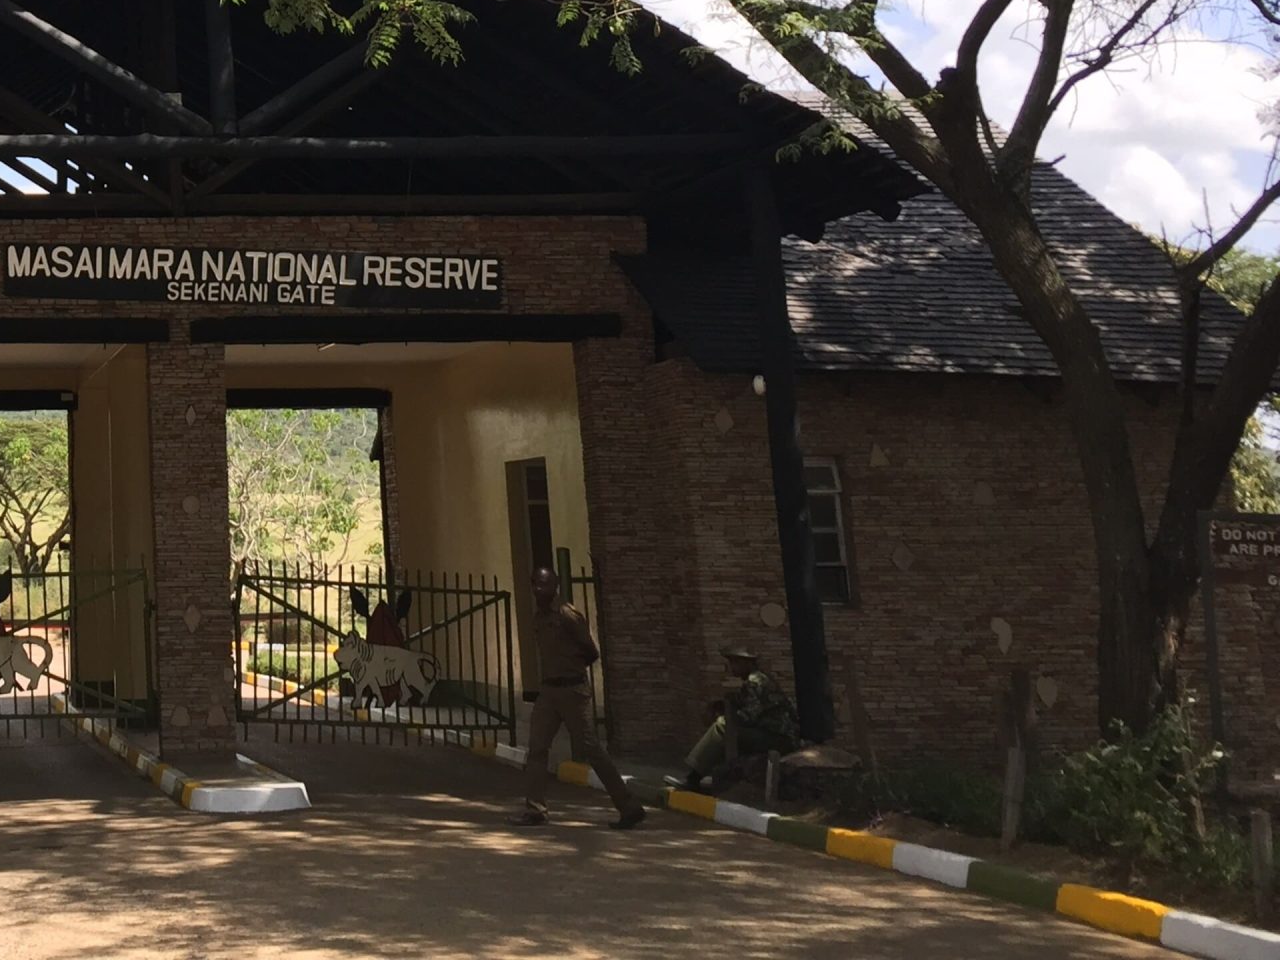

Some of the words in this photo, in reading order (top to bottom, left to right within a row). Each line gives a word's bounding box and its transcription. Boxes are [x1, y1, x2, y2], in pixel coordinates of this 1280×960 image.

[7, 245, 102, 279] MASAI
[108, 247, 195, 281] MARA
[201, 250, 357, 286] NATIONAL
[363, 255, 498, 290] RESERVE
[167, 281, 268, 303] SEKENANI
[277, 283, 336, 305] GATE
[1222, 529, 1242, 540] DO
[1246, 530, 1276, 541] NOT
[1229, 543, 1259, 555] ARE
